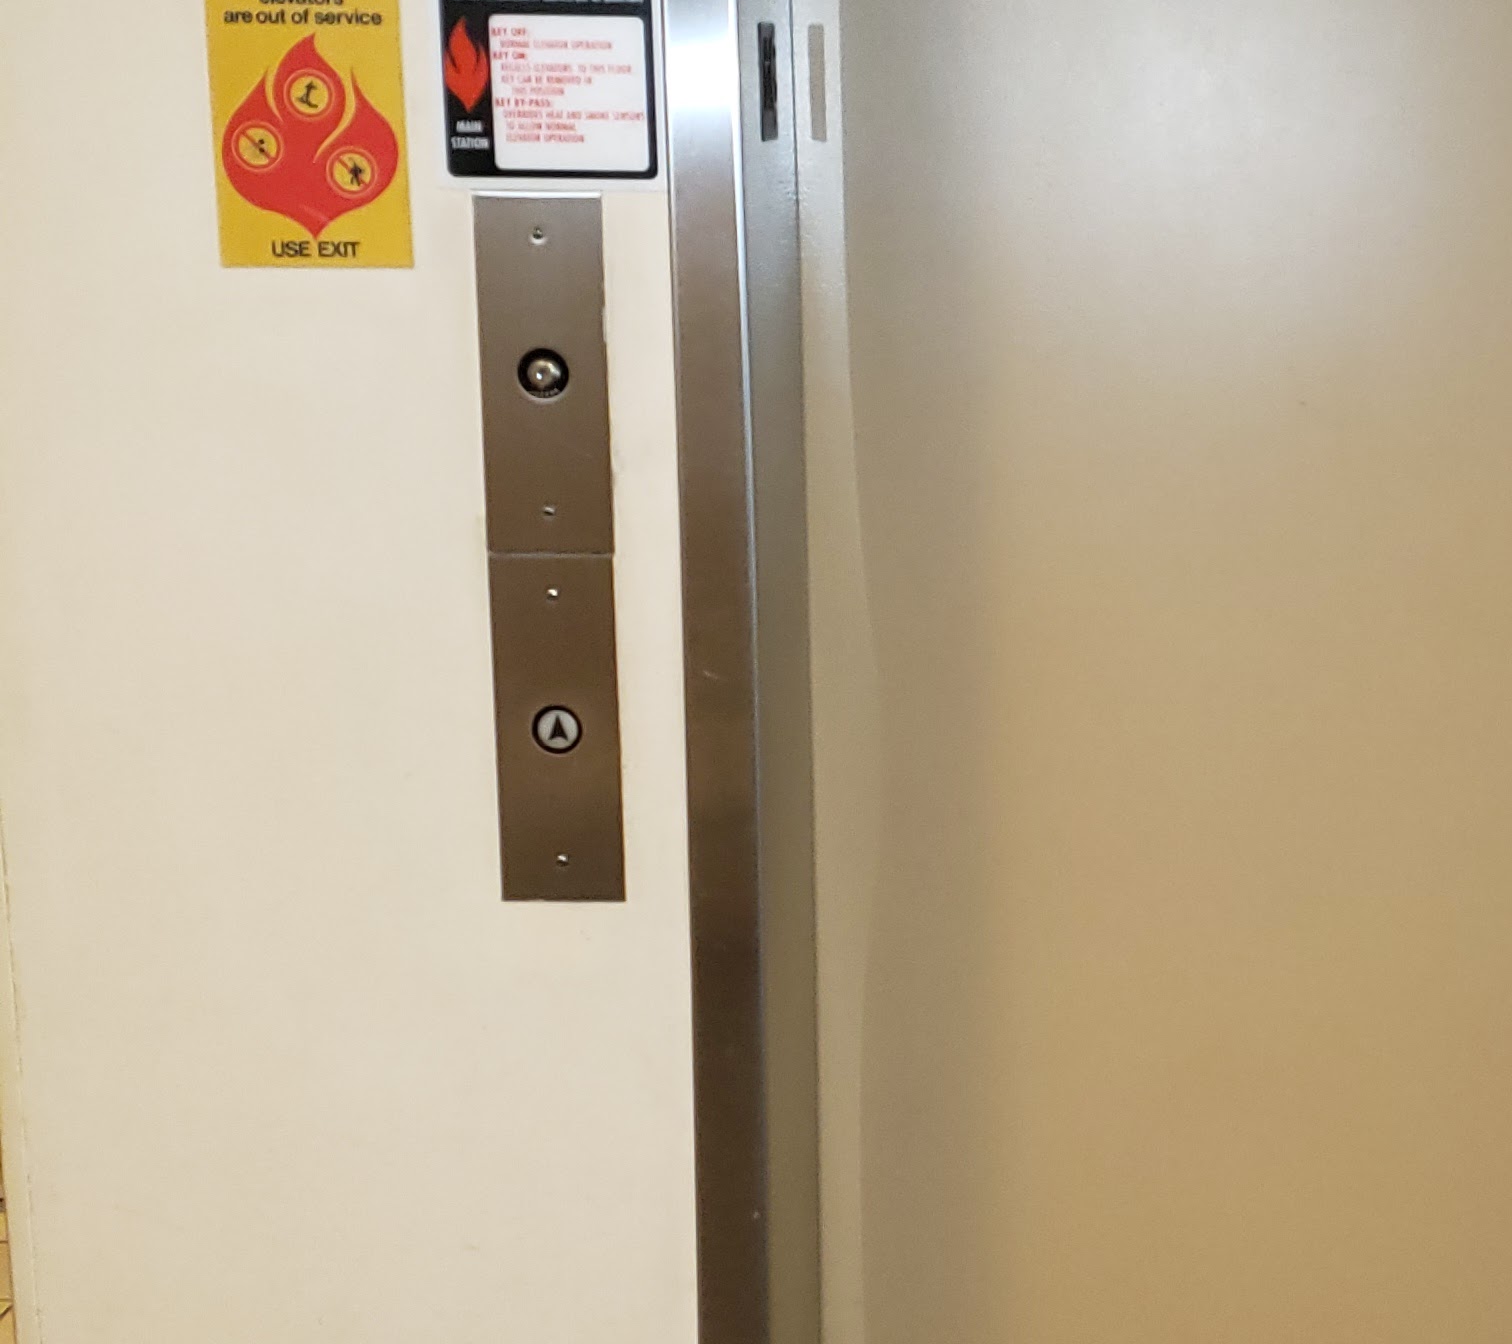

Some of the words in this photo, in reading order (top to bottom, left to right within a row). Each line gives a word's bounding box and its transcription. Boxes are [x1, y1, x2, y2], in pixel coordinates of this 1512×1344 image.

[224, 9, 253, 24] are
[255, 10, 286, 24] out
[291, 8, 309, 24] of
[314, 9, 382, 26] service
[456, 120, 483, 133] MAIN
[451, 137, 490, 150] STATION
[271, 239, 312, 258] USE
[318, 240, 360, 258] EXIT
